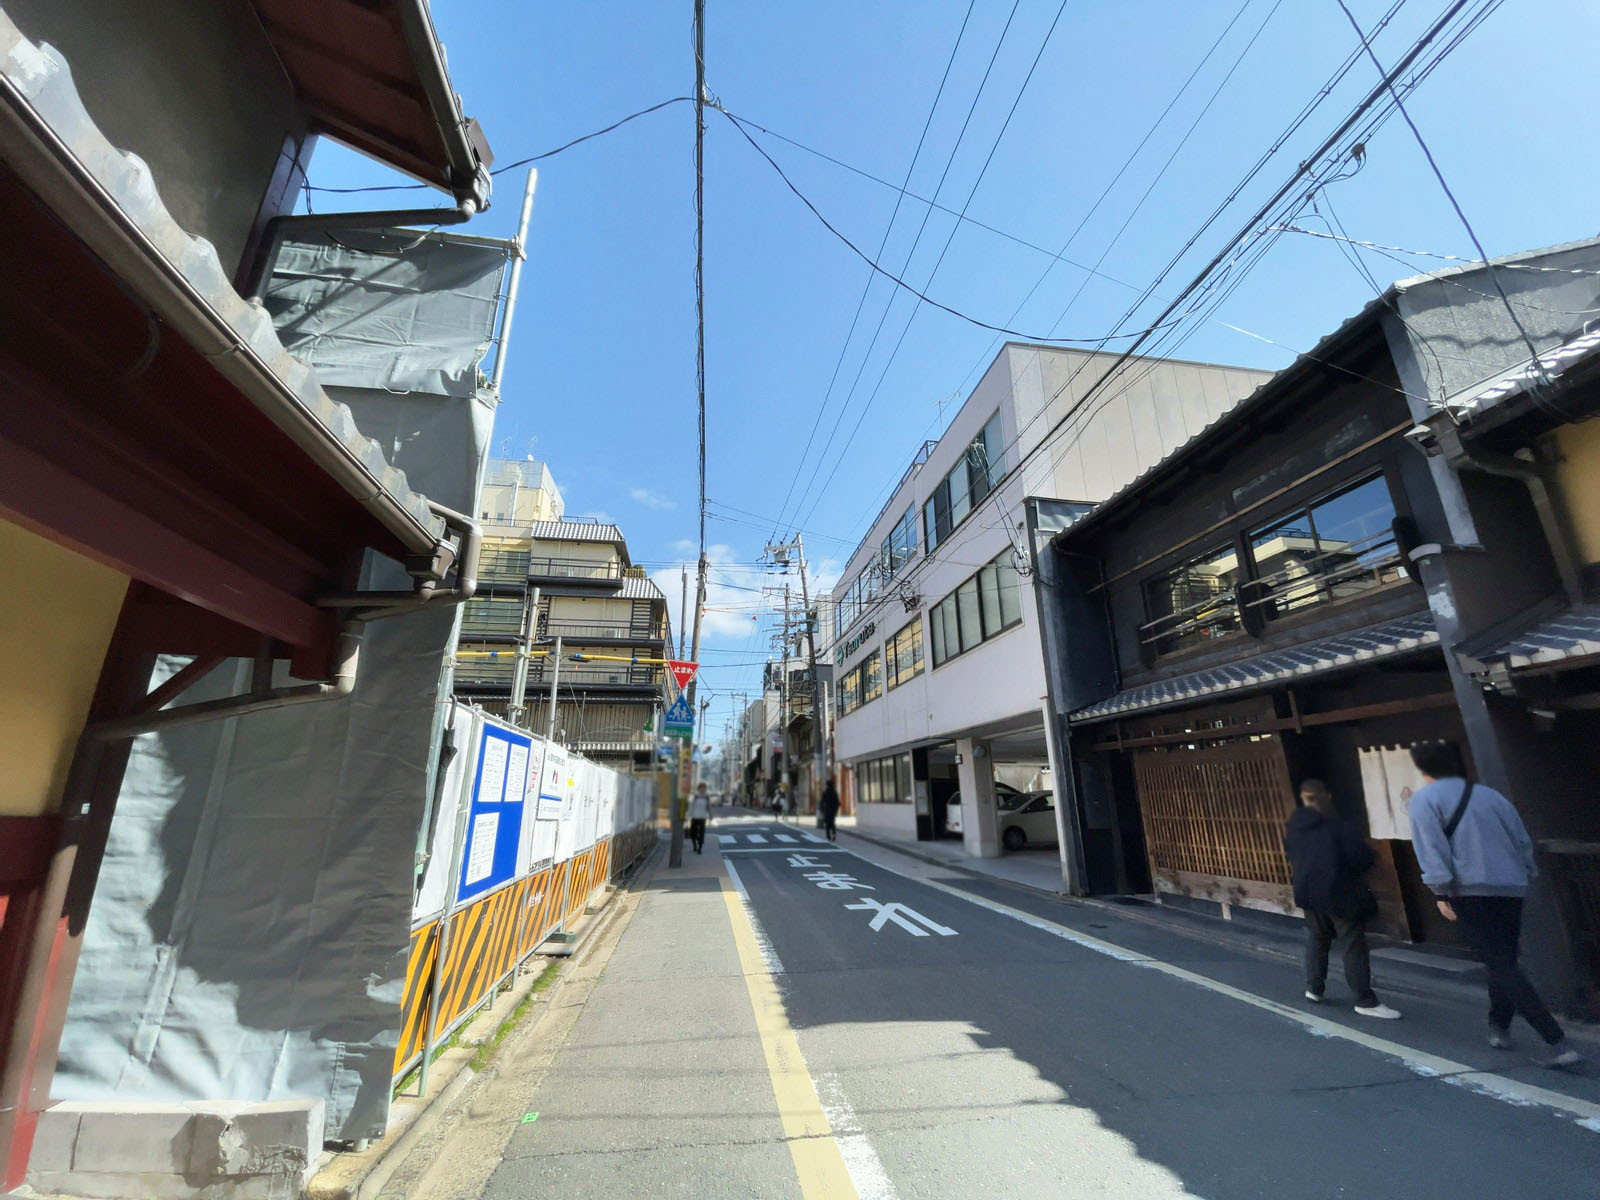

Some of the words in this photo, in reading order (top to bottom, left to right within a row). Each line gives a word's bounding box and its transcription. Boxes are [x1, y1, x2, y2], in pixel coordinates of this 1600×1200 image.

[673, 665, 694, 674] 止まれ
[786, 853, 959, 937] 止まれ
